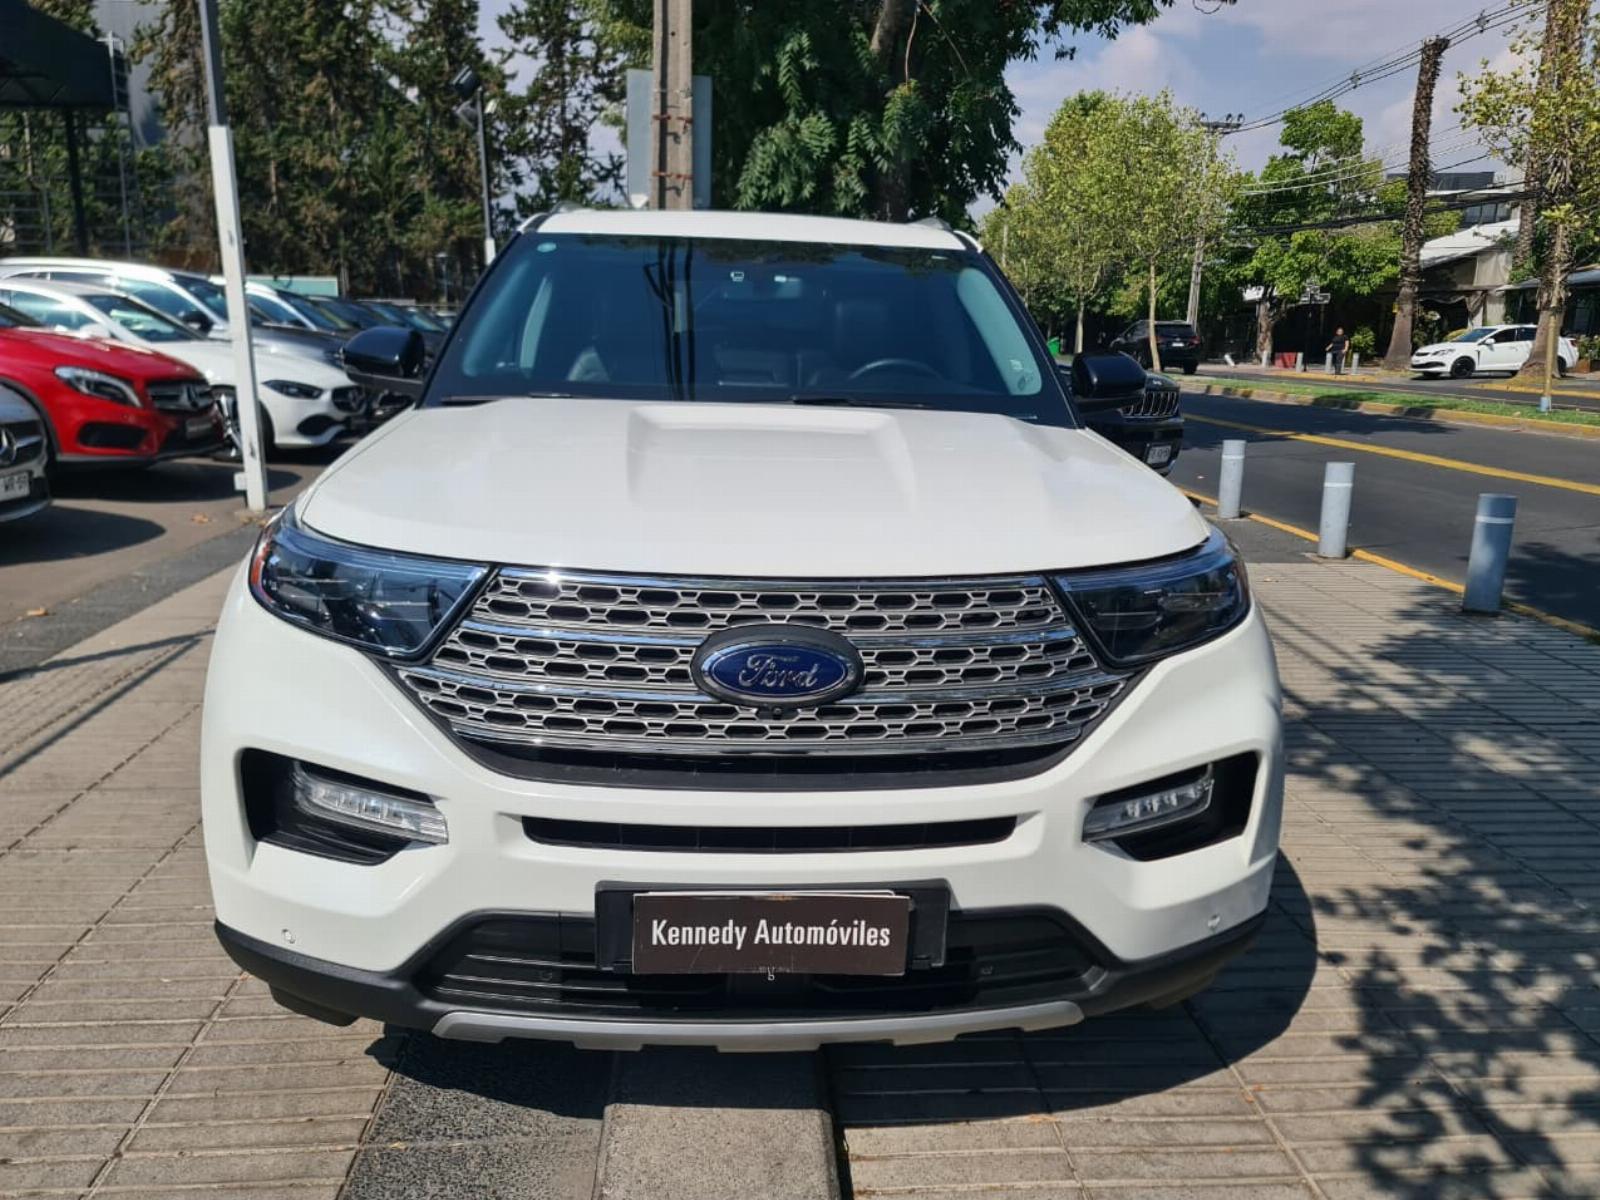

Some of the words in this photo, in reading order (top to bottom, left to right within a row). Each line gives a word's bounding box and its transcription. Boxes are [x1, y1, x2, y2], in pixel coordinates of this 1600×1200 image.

[738, 654, 819, 688] Ford
[651, 919, 747, 950] Kennedy
[753, 918, 891, 946] Automóviles
